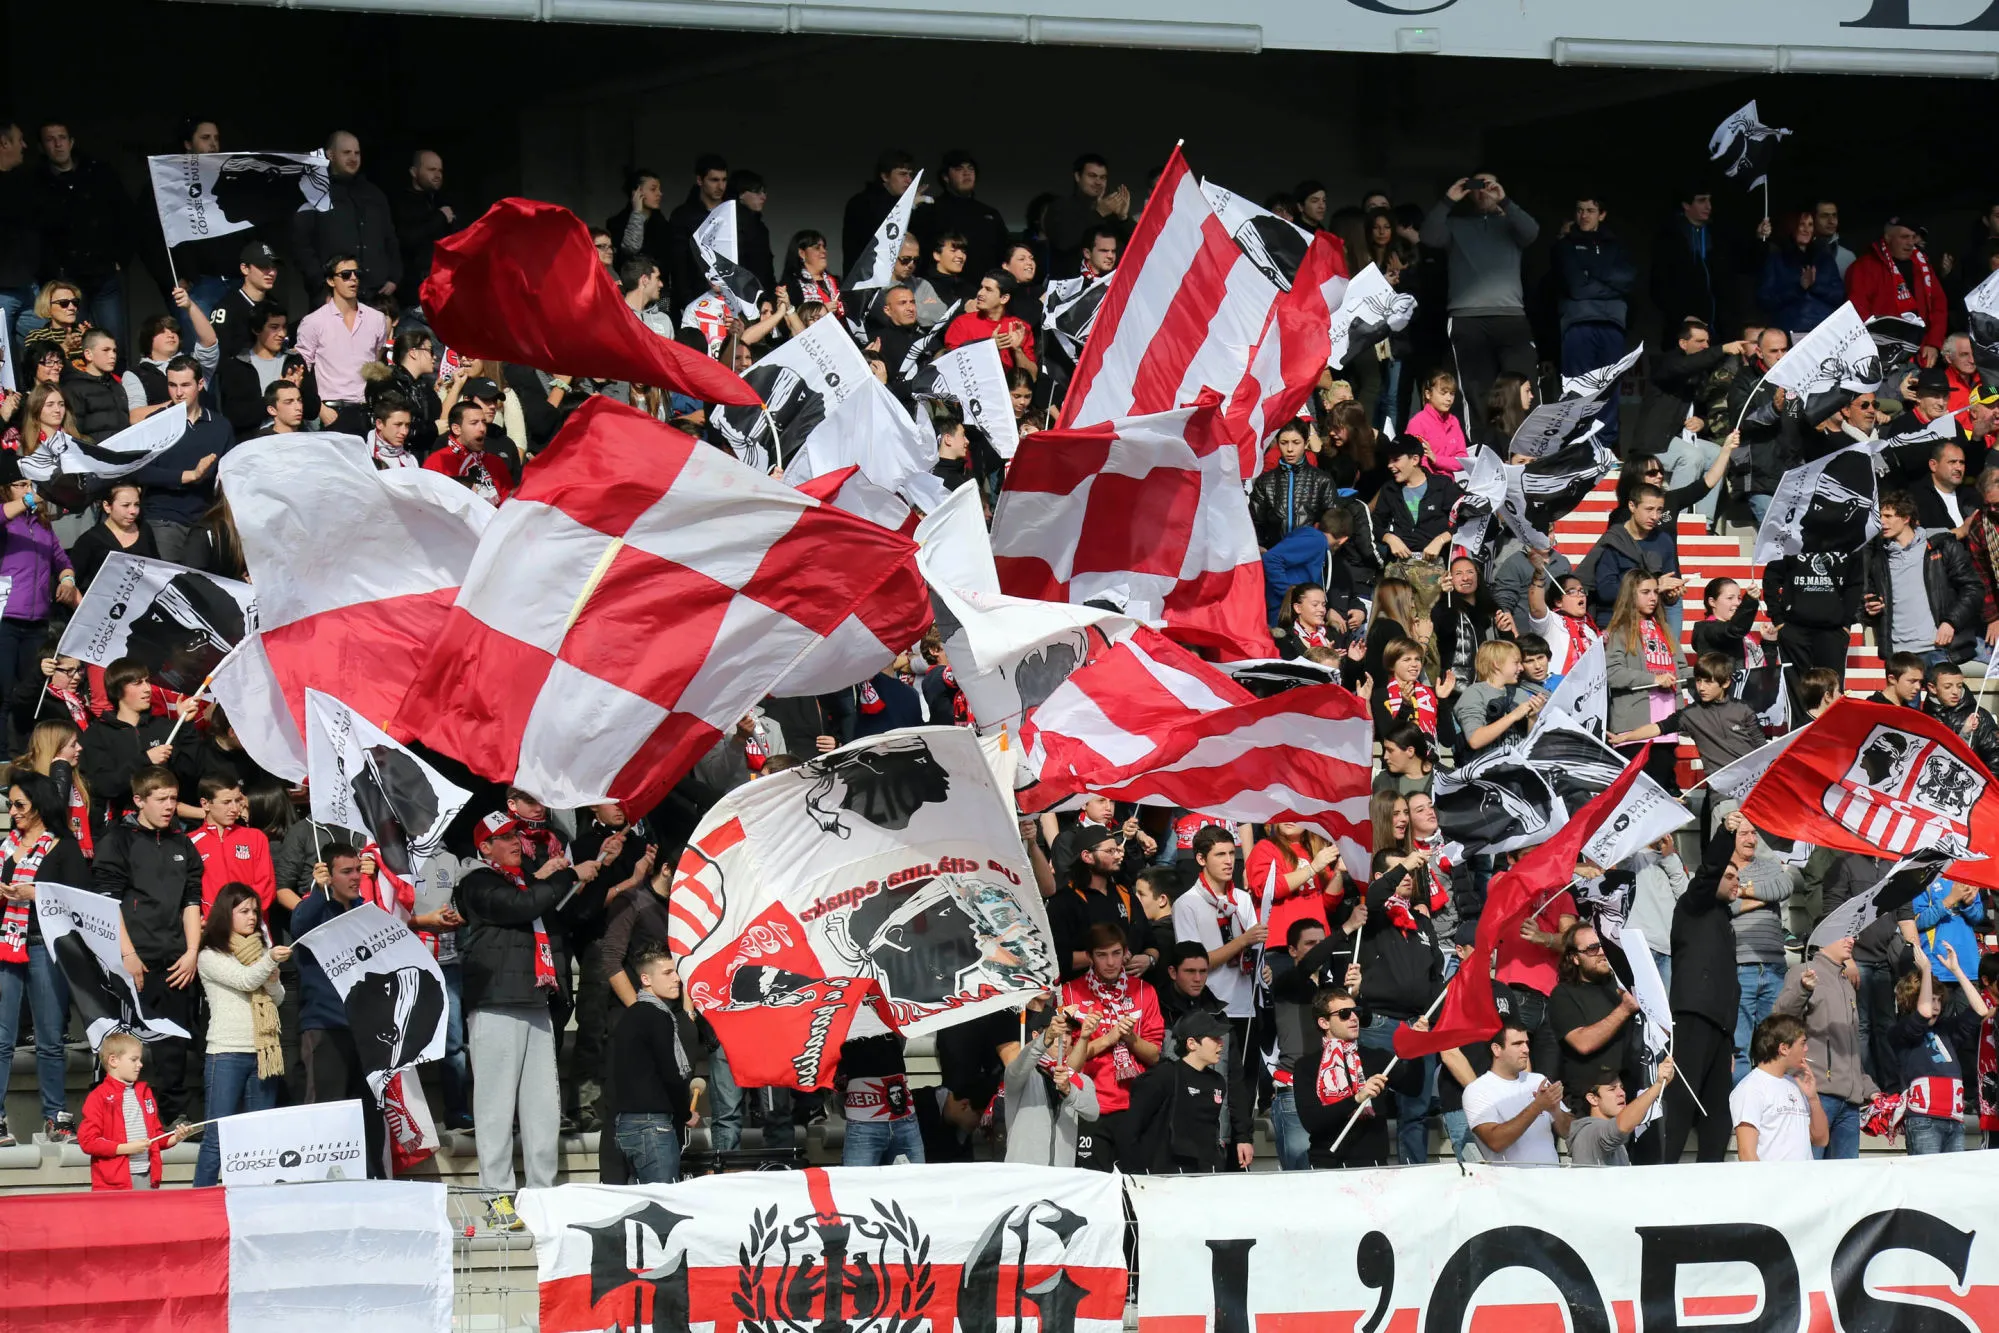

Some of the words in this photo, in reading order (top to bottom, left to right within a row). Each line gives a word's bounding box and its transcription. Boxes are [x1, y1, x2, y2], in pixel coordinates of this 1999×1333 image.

[93, 622, 117, 662] CORSE
[122, 583, 135, 602] DU
[133, 559, 146, 583] SUD
[84, 922, 97, 933] DU
[98, 927, 117, 941] SUD
[371, 939, 387, 954] DU
[387, 928, 409, 945] SUD
[227, 1149, 280, 1160] CONSEIL
[300, 1140, 360, 1152] GENERAL
[1078, 1135, 1092, 1149] 20
[226, 1157, 277, 1173] CORSE
[304, 1152, 328, 1164] DU
[328, 1149, 361, 1162] SUD
